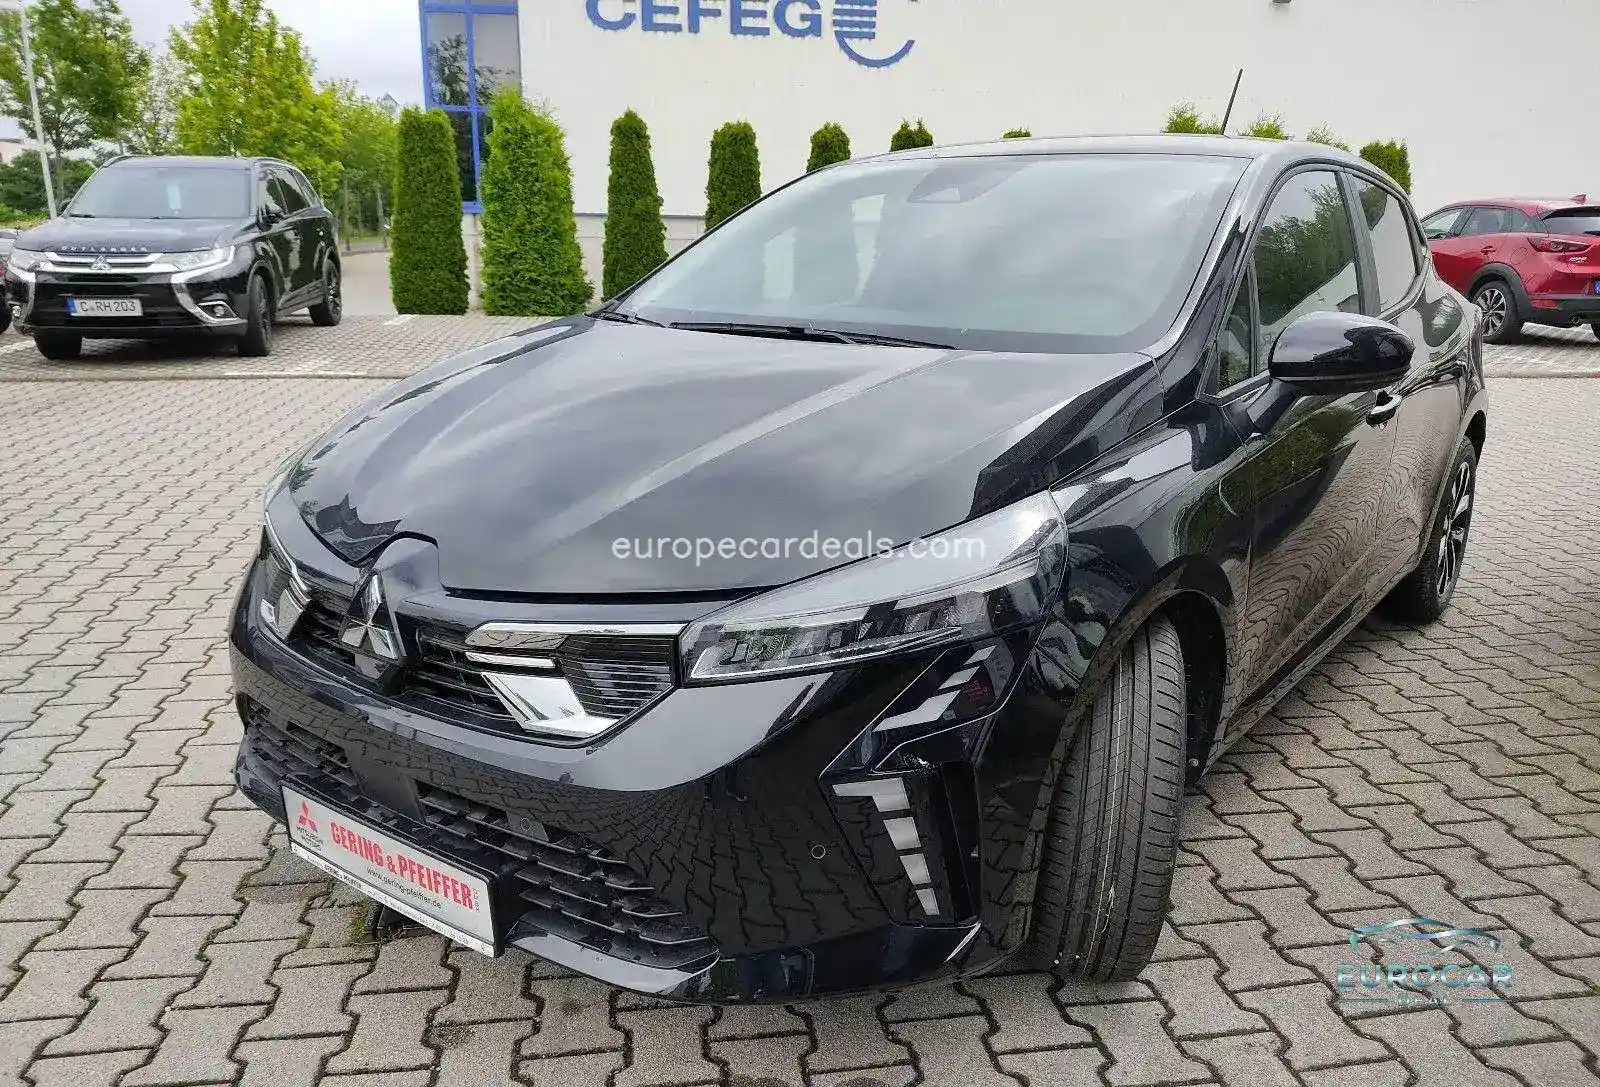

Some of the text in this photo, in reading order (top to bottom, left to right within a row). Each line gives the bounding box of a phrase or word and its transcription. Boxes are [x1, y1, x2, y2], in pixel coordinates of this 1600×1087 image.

[585, 0, 821, 38] CEFEG
[80, 301, 136, 312] C RH 203
[331, 821, 473, 910] GERING & PFEIFFER
